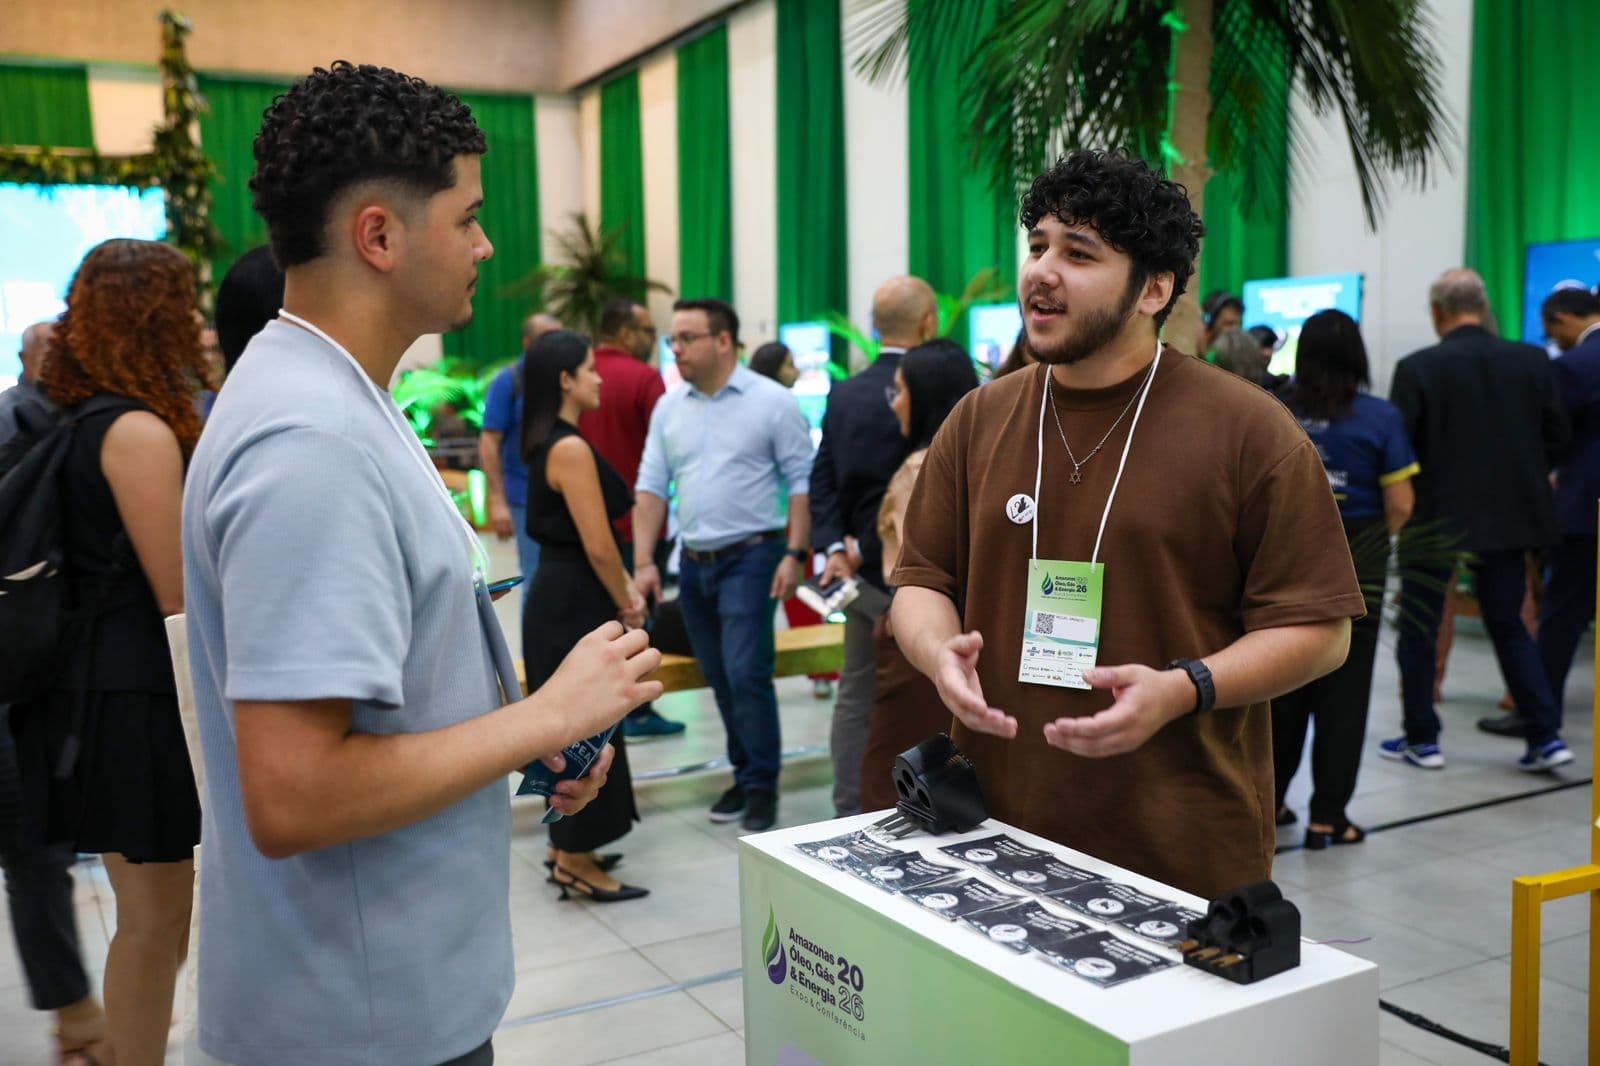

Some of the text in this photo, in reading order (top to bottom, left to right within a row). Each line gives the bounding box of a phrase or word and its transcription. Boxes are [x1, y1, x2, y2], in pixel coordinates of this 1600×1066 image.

[1076, 585, 1087, 593] 26
[789, 927, 835, 965] Amazonas
[789, 944, 835, 985] Óleo, Gás
[837, 957, 864, 992] 20
[790, 966, 836, 1006] & Energia
[790, 984, 809, 1003] Expo
[838, 985, 864, 1021] 26
